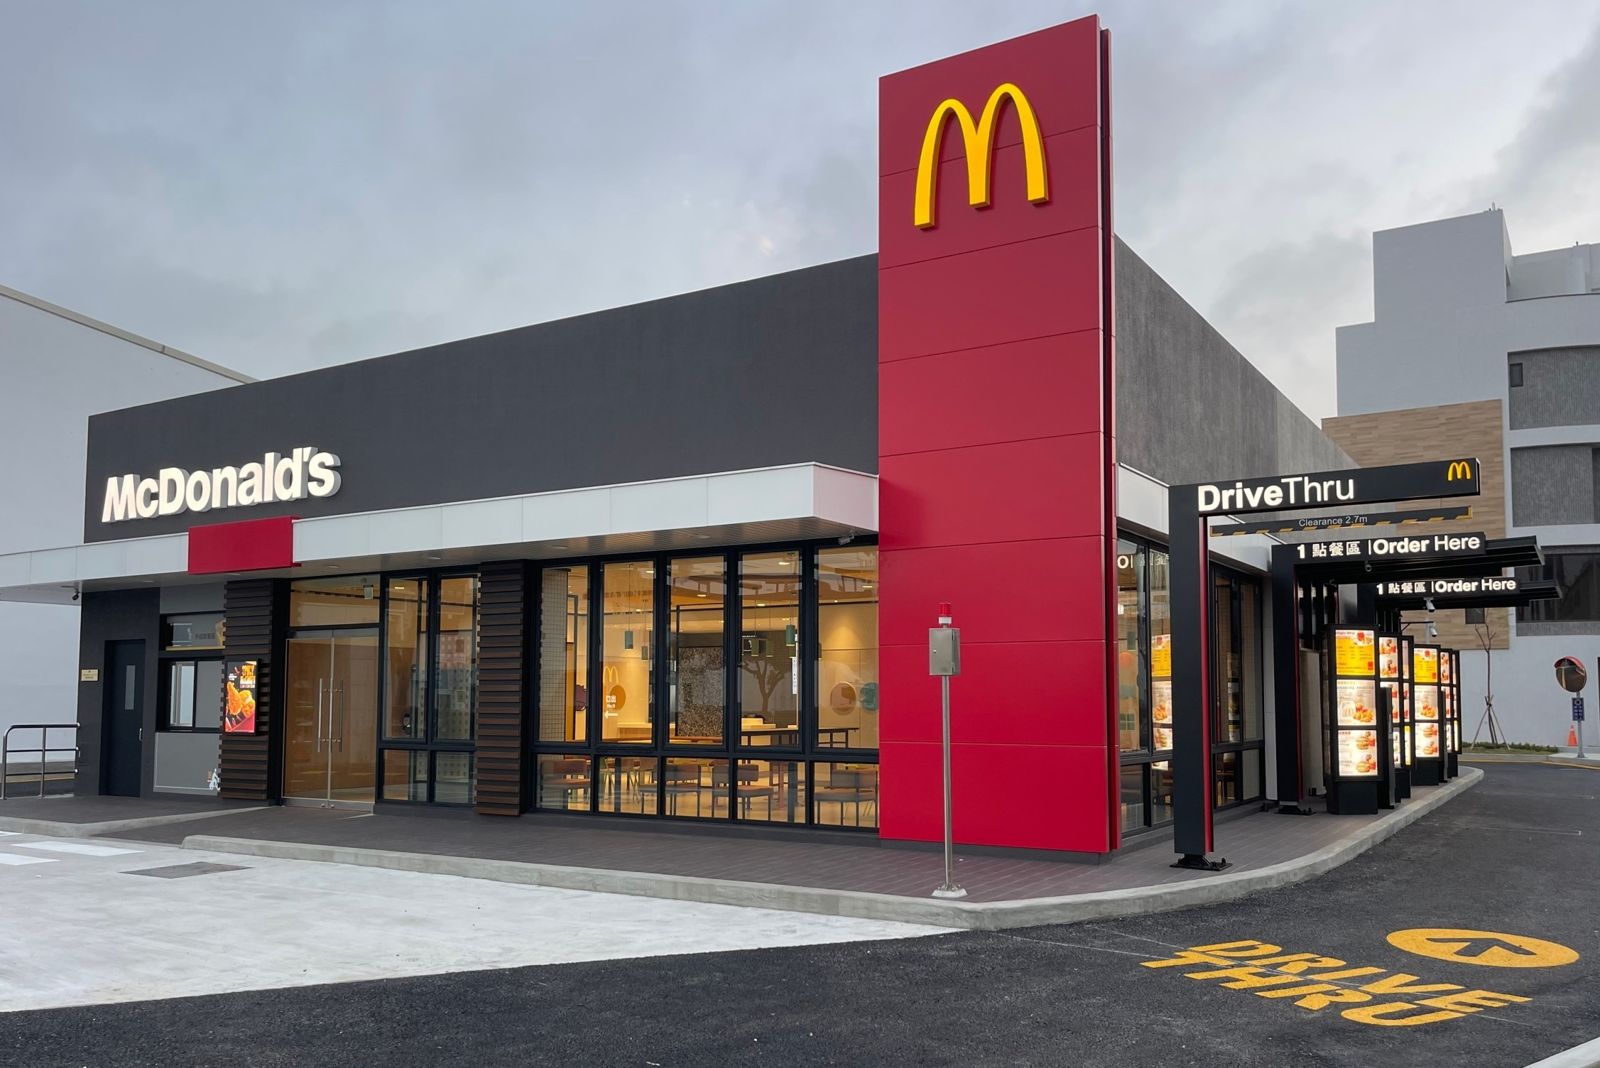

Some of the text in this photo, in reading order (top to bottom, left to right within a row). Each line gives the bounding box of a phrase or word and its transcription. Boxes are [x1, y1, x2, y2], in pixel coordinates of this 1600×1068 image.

[914, 82, 1048, 229] M
[101, 446, 341, 523] McDonald's
[1298, 515, 1368, 527] Clearance 2.7m
[1297, 544, 1306, 559] 1
[1312, 541, 1361, 558] 點餐區
[1434, 534, 1481, 551] Here
[1376, 583, 1384, 595] 1
[1481, 578, 1517, 591] Here
[1139, 951, 1468, 1026] THRU
[1189, 940, 1534, 1013] DRIVE
